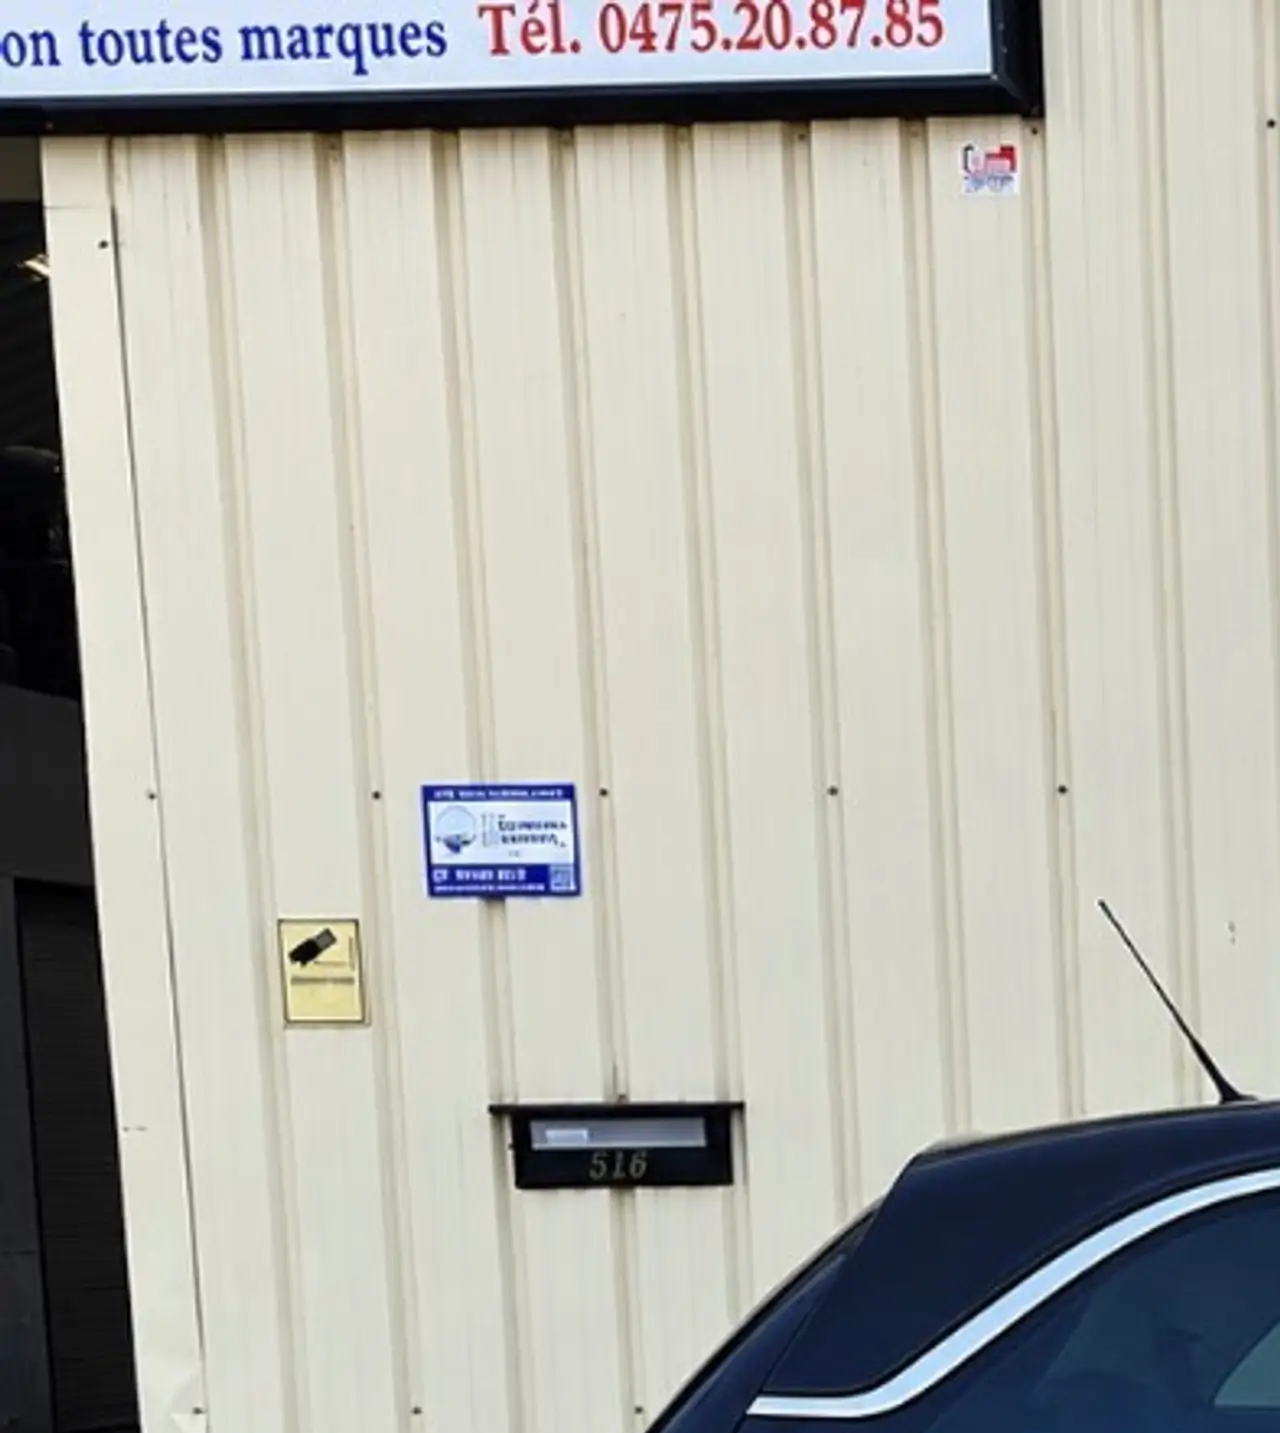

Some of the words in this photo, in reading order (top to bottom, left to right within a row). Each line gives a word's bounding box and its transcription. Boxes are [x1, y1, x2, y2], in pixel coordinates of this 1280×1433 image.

[78, 20, 224, 67] toutes
[238, 20, 448, 76] marques
[478, 0, 581, 55] Tél.
[598, 0, 944, 54] 0475.20.87.85
[589, 1149, 648, 1180] 516
